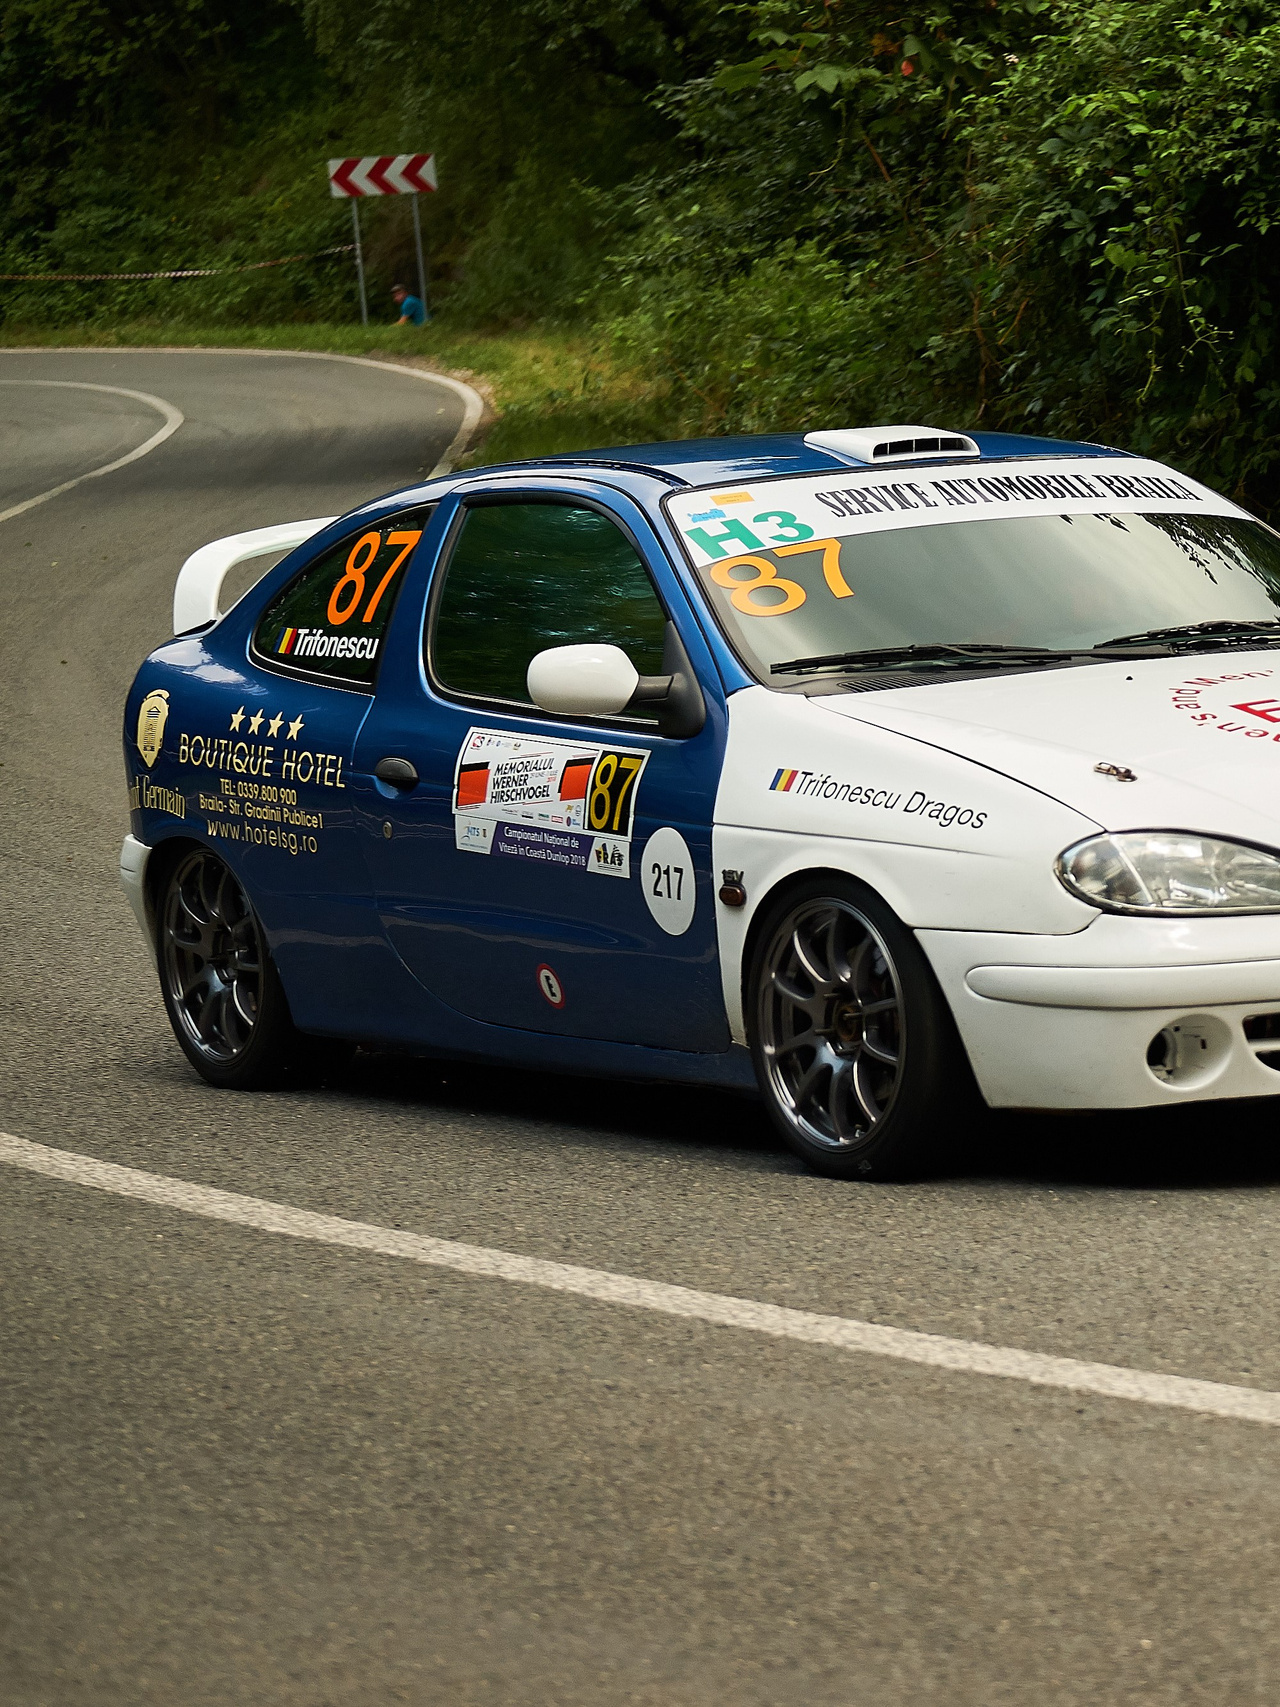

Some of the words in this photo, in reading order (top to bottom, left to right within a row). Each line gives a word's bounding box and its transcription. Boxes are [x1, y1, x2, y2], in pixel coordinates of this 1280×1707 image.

[814, 482, 938, 518] SERVICE
[929, 473, 1105, 506] AUTOMOBILE
[1092, 474, 1204, 502] BRAILA
[684, 510, 815, 560] H3
[327, 530, 423, 626] 87
[710, 537, 855, 617] 87
[294, 628, 380, 659] Trifonescu
[1168, 687, 1203, 710] and
[178, 732, 274, 777] BOUTIQUE
[281, 748, 347, 789] HOTEL
[494, 757, 555, 777] MEMORIALUL
[143, 775, 186, 820] Germain
[219, 777, 237, 796] TEL:
[237, 781, 279, 803] 0339.800
[279, 787, 298, 806] 900
[489, 784, 551, 804] HIRSCHVOGEL
[492, 773, 530, 790] WERNER
[589, 754, 643, 832] 87
[795, 770, 902, 810] Trifonescu
[903, 790, 989, 829] Dragos
[206, 819, 319, 856] www.hotelsg.ro
[503, 826, 544, 842] Campionatul
[571, 837, 580, 849] de
[546, 849, 570, 866] Dunlop
[570, 854, 587, 867] 2018
[651, 862, 684, 901] 217
